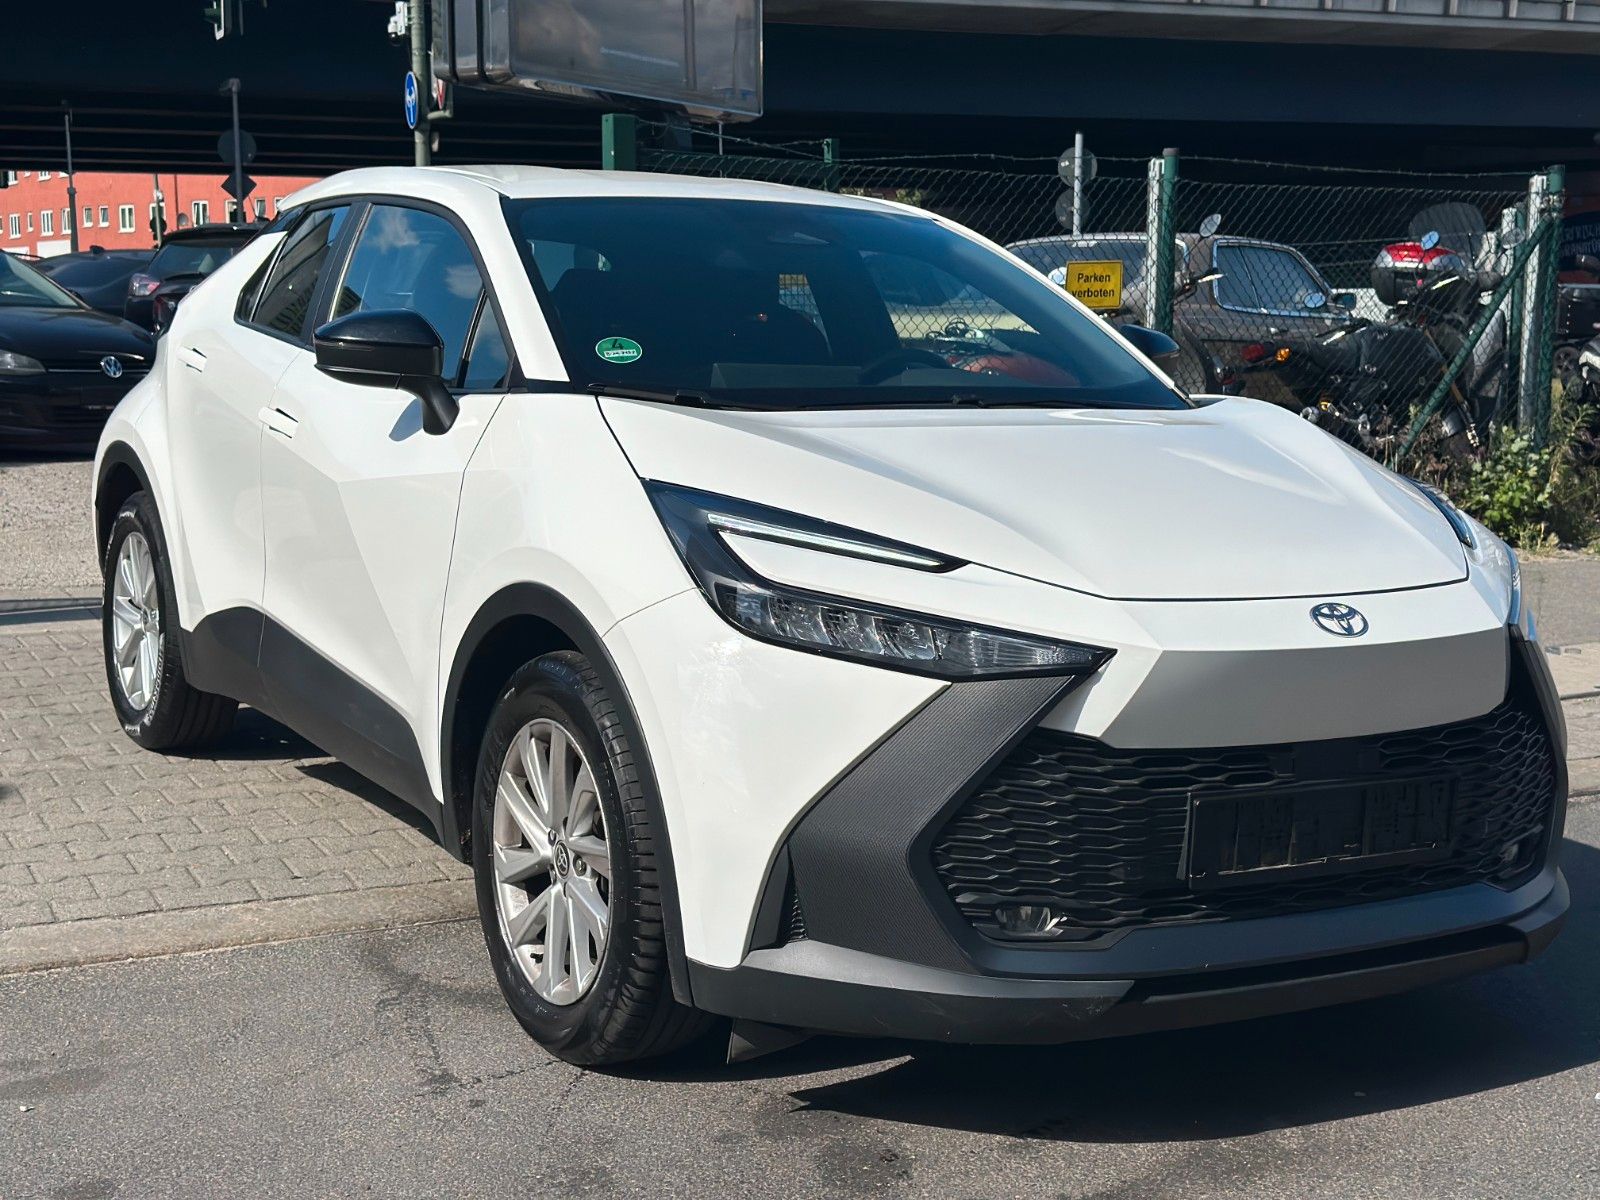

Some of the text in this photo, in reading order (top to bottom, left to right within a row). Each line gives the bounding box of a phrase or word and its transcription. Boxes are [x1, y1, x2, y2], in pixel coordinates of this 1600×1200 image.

[1077, 272, 1111, 283] Parken
[1072, 287, 1115, 298] verboten
[612, 339, 624, 349] 4
